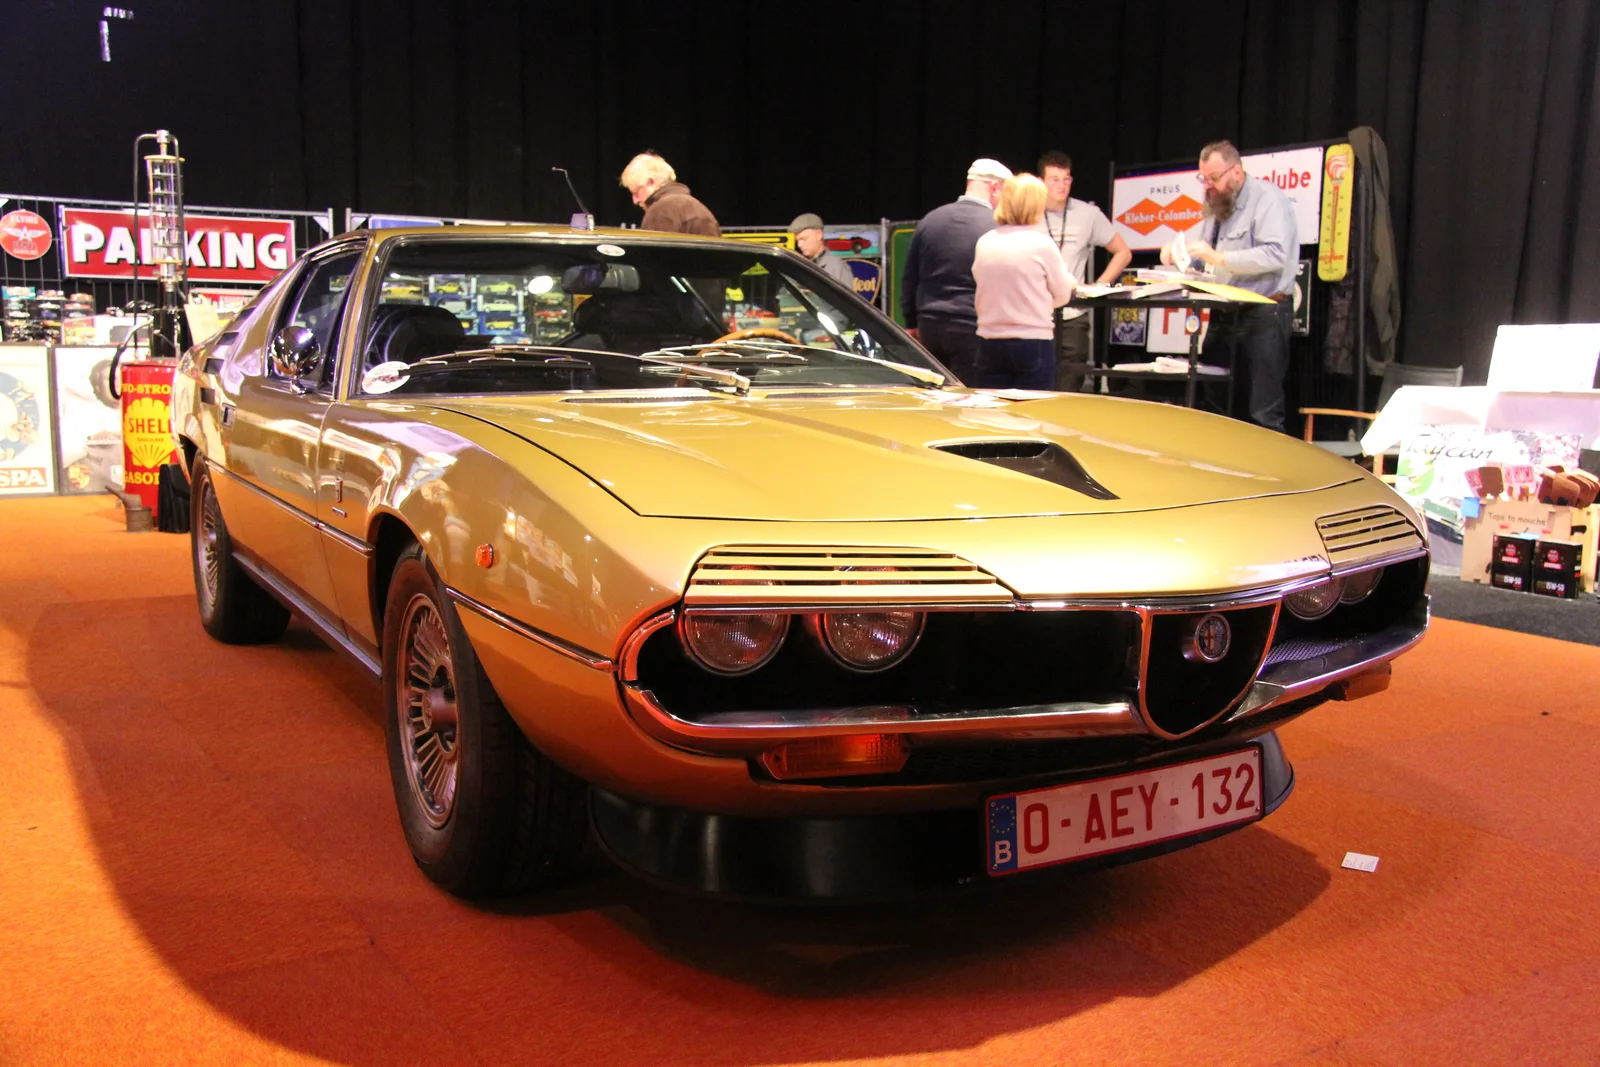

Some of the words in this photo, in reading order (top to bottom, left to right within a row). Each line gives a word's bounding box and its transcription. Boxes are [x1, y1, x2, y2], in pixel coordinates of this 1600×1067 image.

[1150, 185, 1180, 194] PNEUS
[1254, 168, 1311, 190] lube
[995, 840, 1012, 865] B
